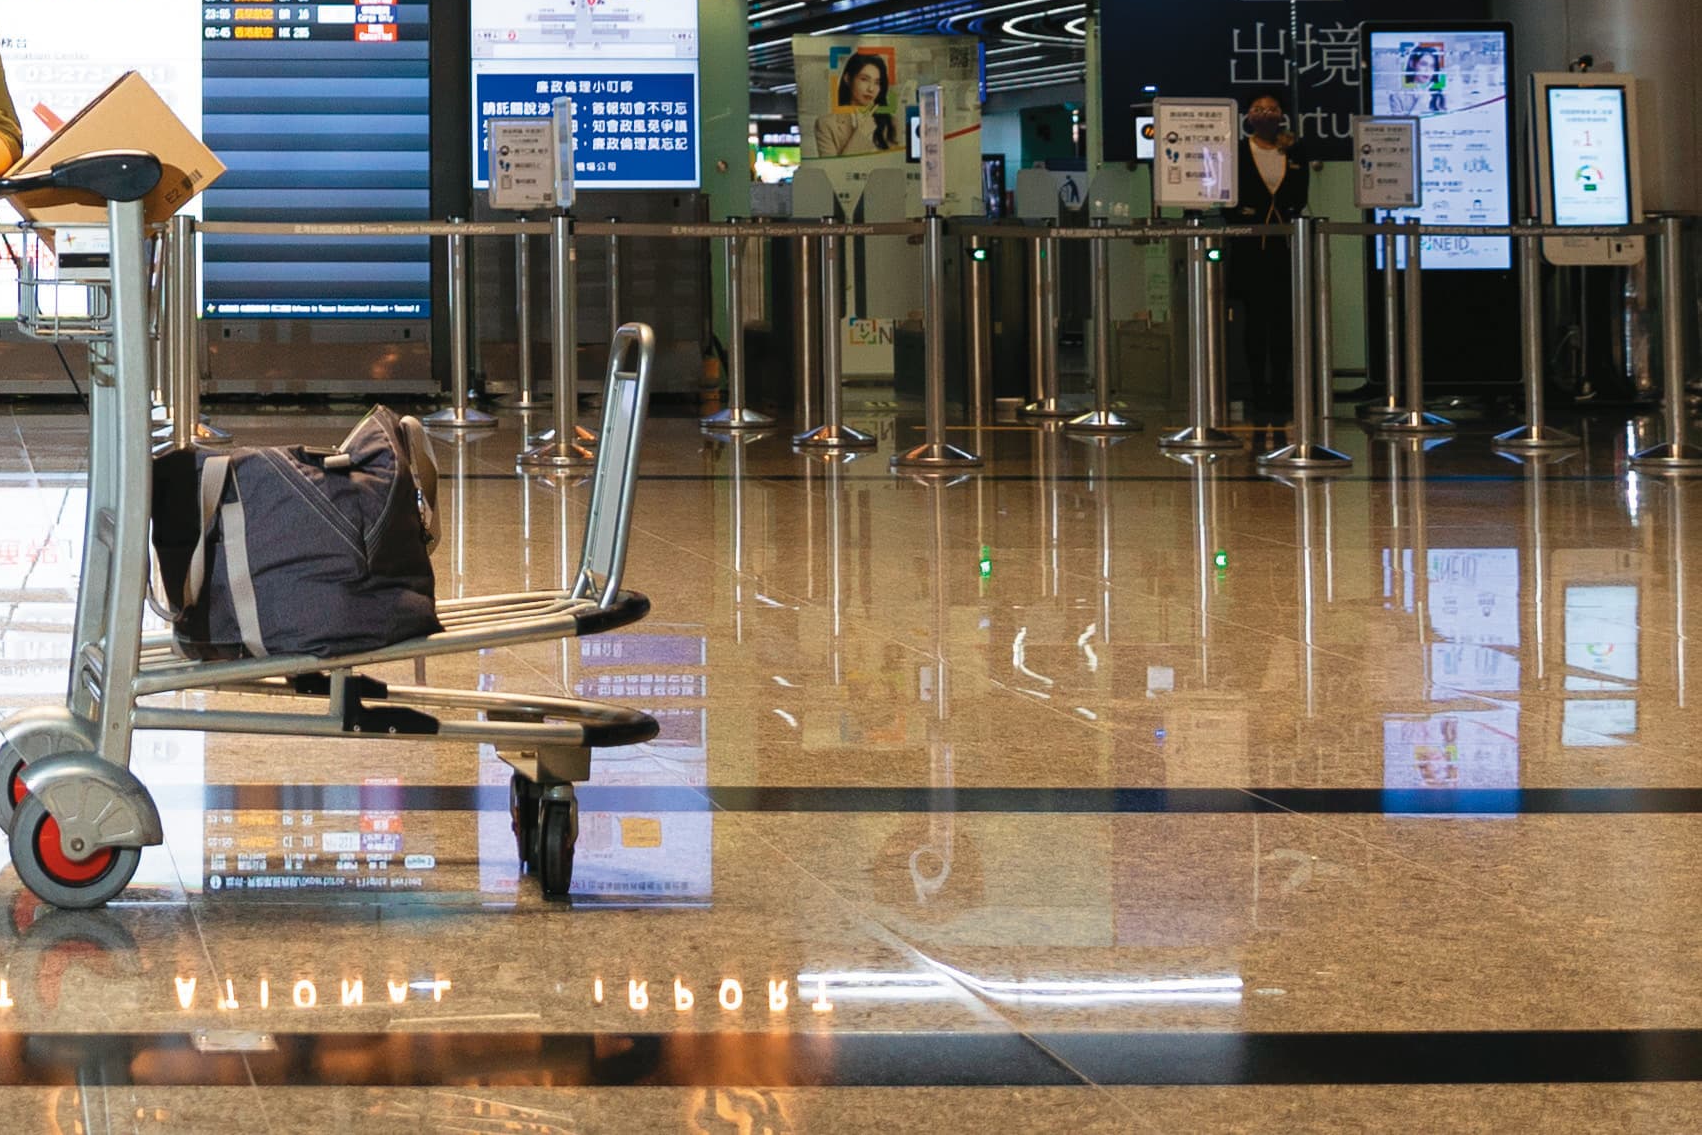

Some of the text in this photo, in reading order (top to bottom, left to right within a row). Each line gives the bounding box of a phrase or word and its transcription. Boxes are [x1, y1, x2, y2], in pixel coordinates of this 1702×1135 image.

[1230, 21, 1360, 87] 出境
[361, 225, 385, 235] Taiwan
[388, 225, 418, 236] Taoyuan
[420, 224, 467, 235] International
[469, 224, 496, 236] Airport
